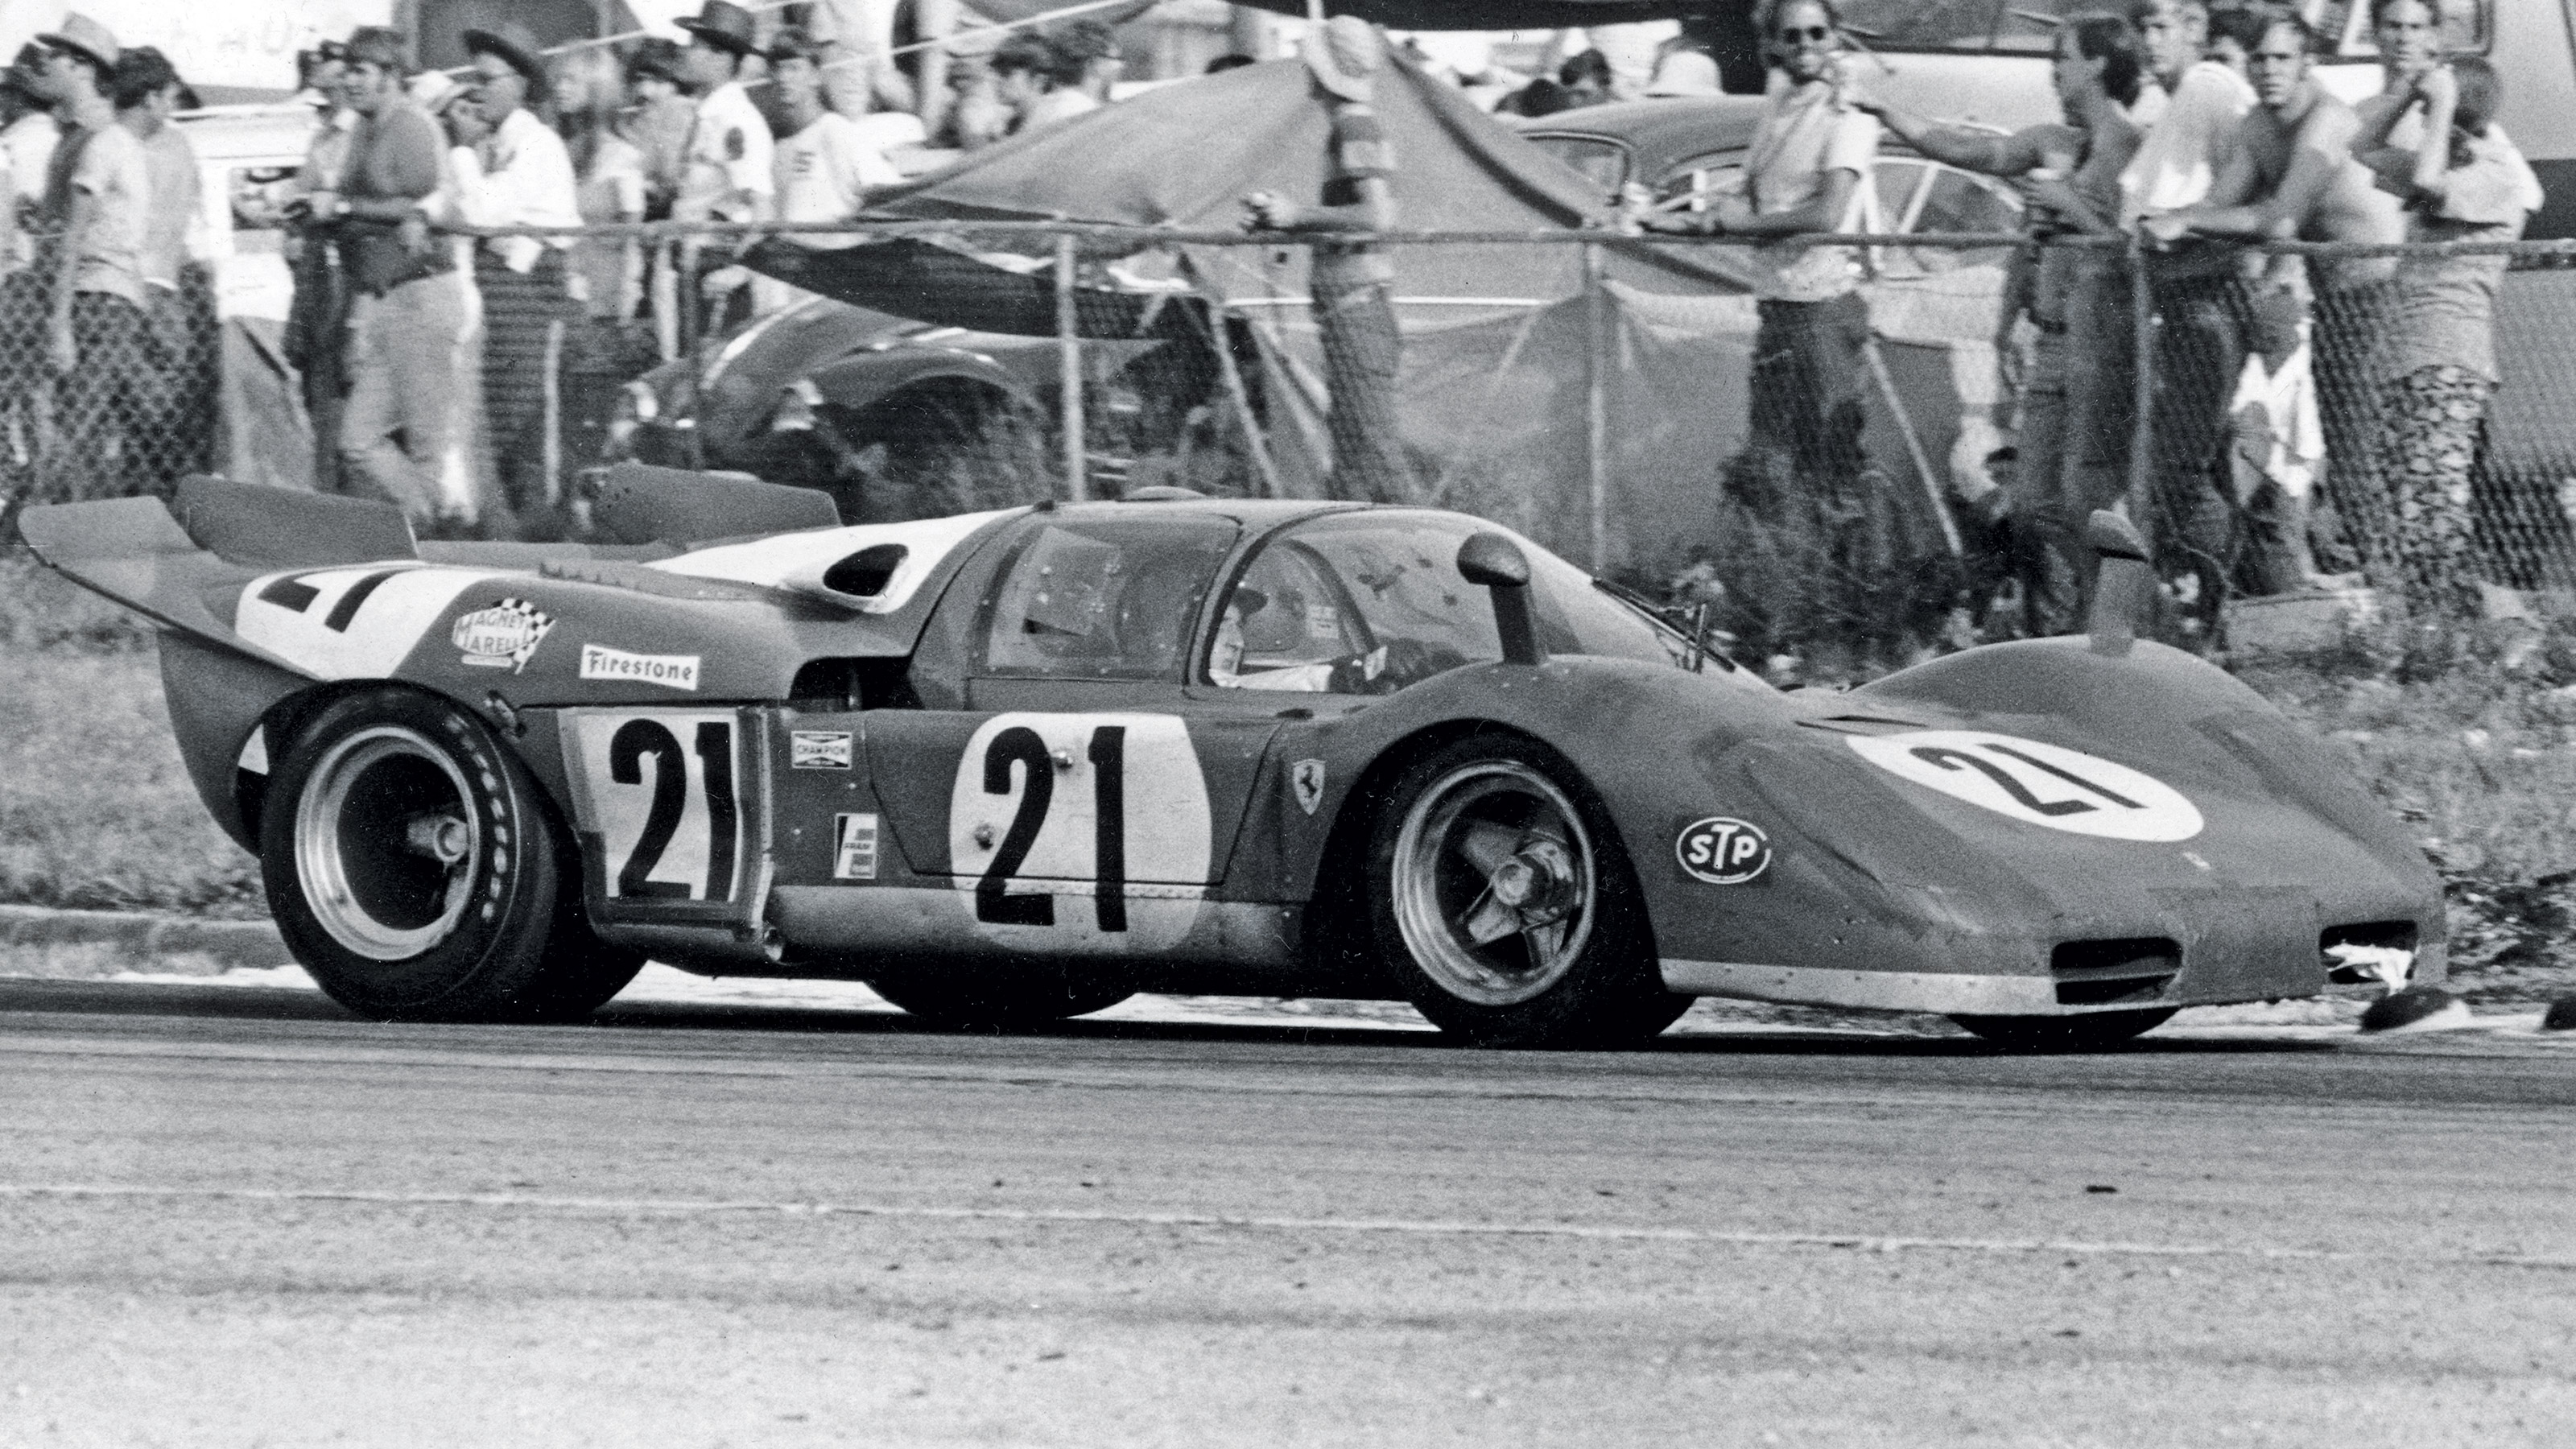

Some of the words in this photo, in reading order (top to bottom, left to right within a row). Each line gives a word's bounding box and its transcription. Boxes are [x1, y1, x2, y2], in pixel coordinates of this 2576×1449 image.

[587, 650, 692, 680] Firestone
[796, 744, 846, 755] CHAMPION
[1909, 742, 2149, 816] 21
[609, 718, 737, 901] 21
[976, 726, 1127, 932] 21
[1688, 824, 1758, 869] STP
